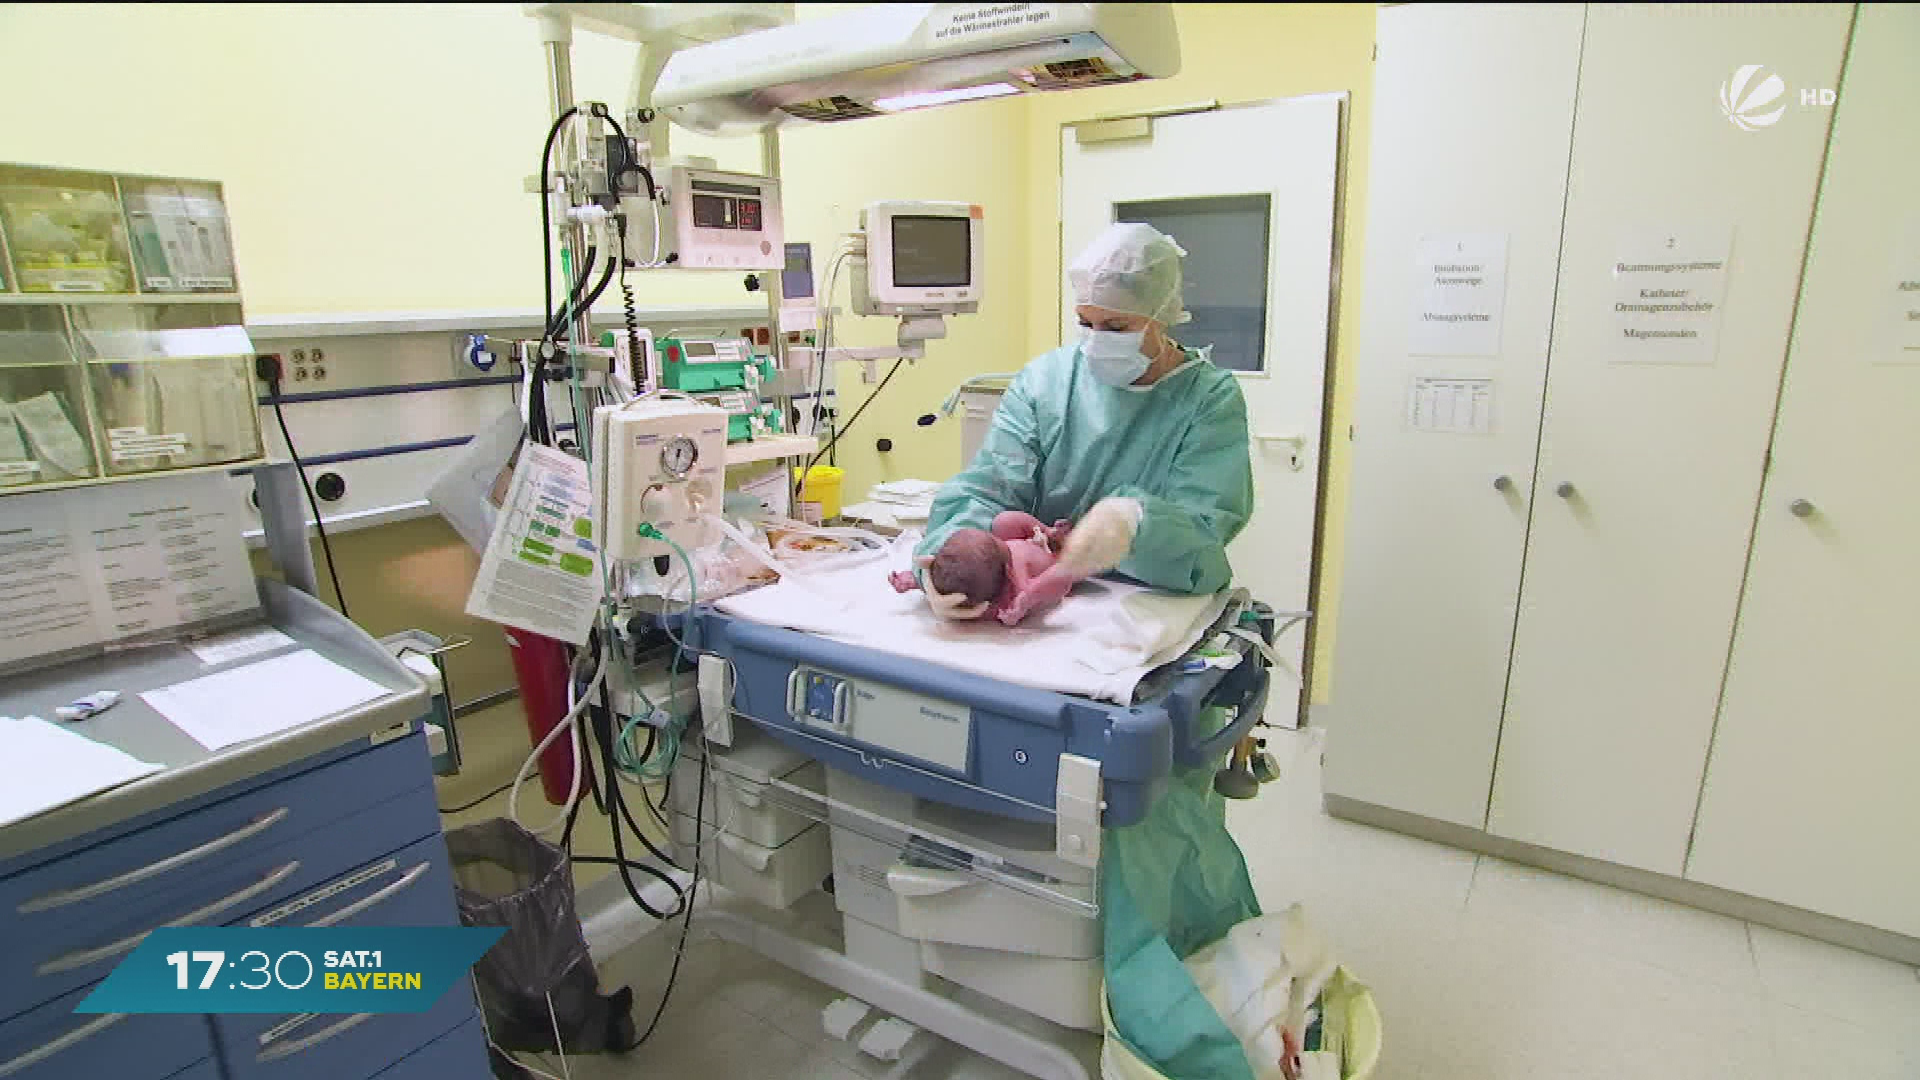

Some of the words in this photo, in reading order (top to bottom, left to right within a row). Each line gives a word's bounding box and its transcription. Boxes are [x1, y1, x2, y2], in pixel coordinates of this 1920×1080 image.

[936, 28, 948, 37] auf
[949, 27, 961, 35] die
[1026, 11, 1049, 22] legen
[953, 12, 976, 23] Keine
